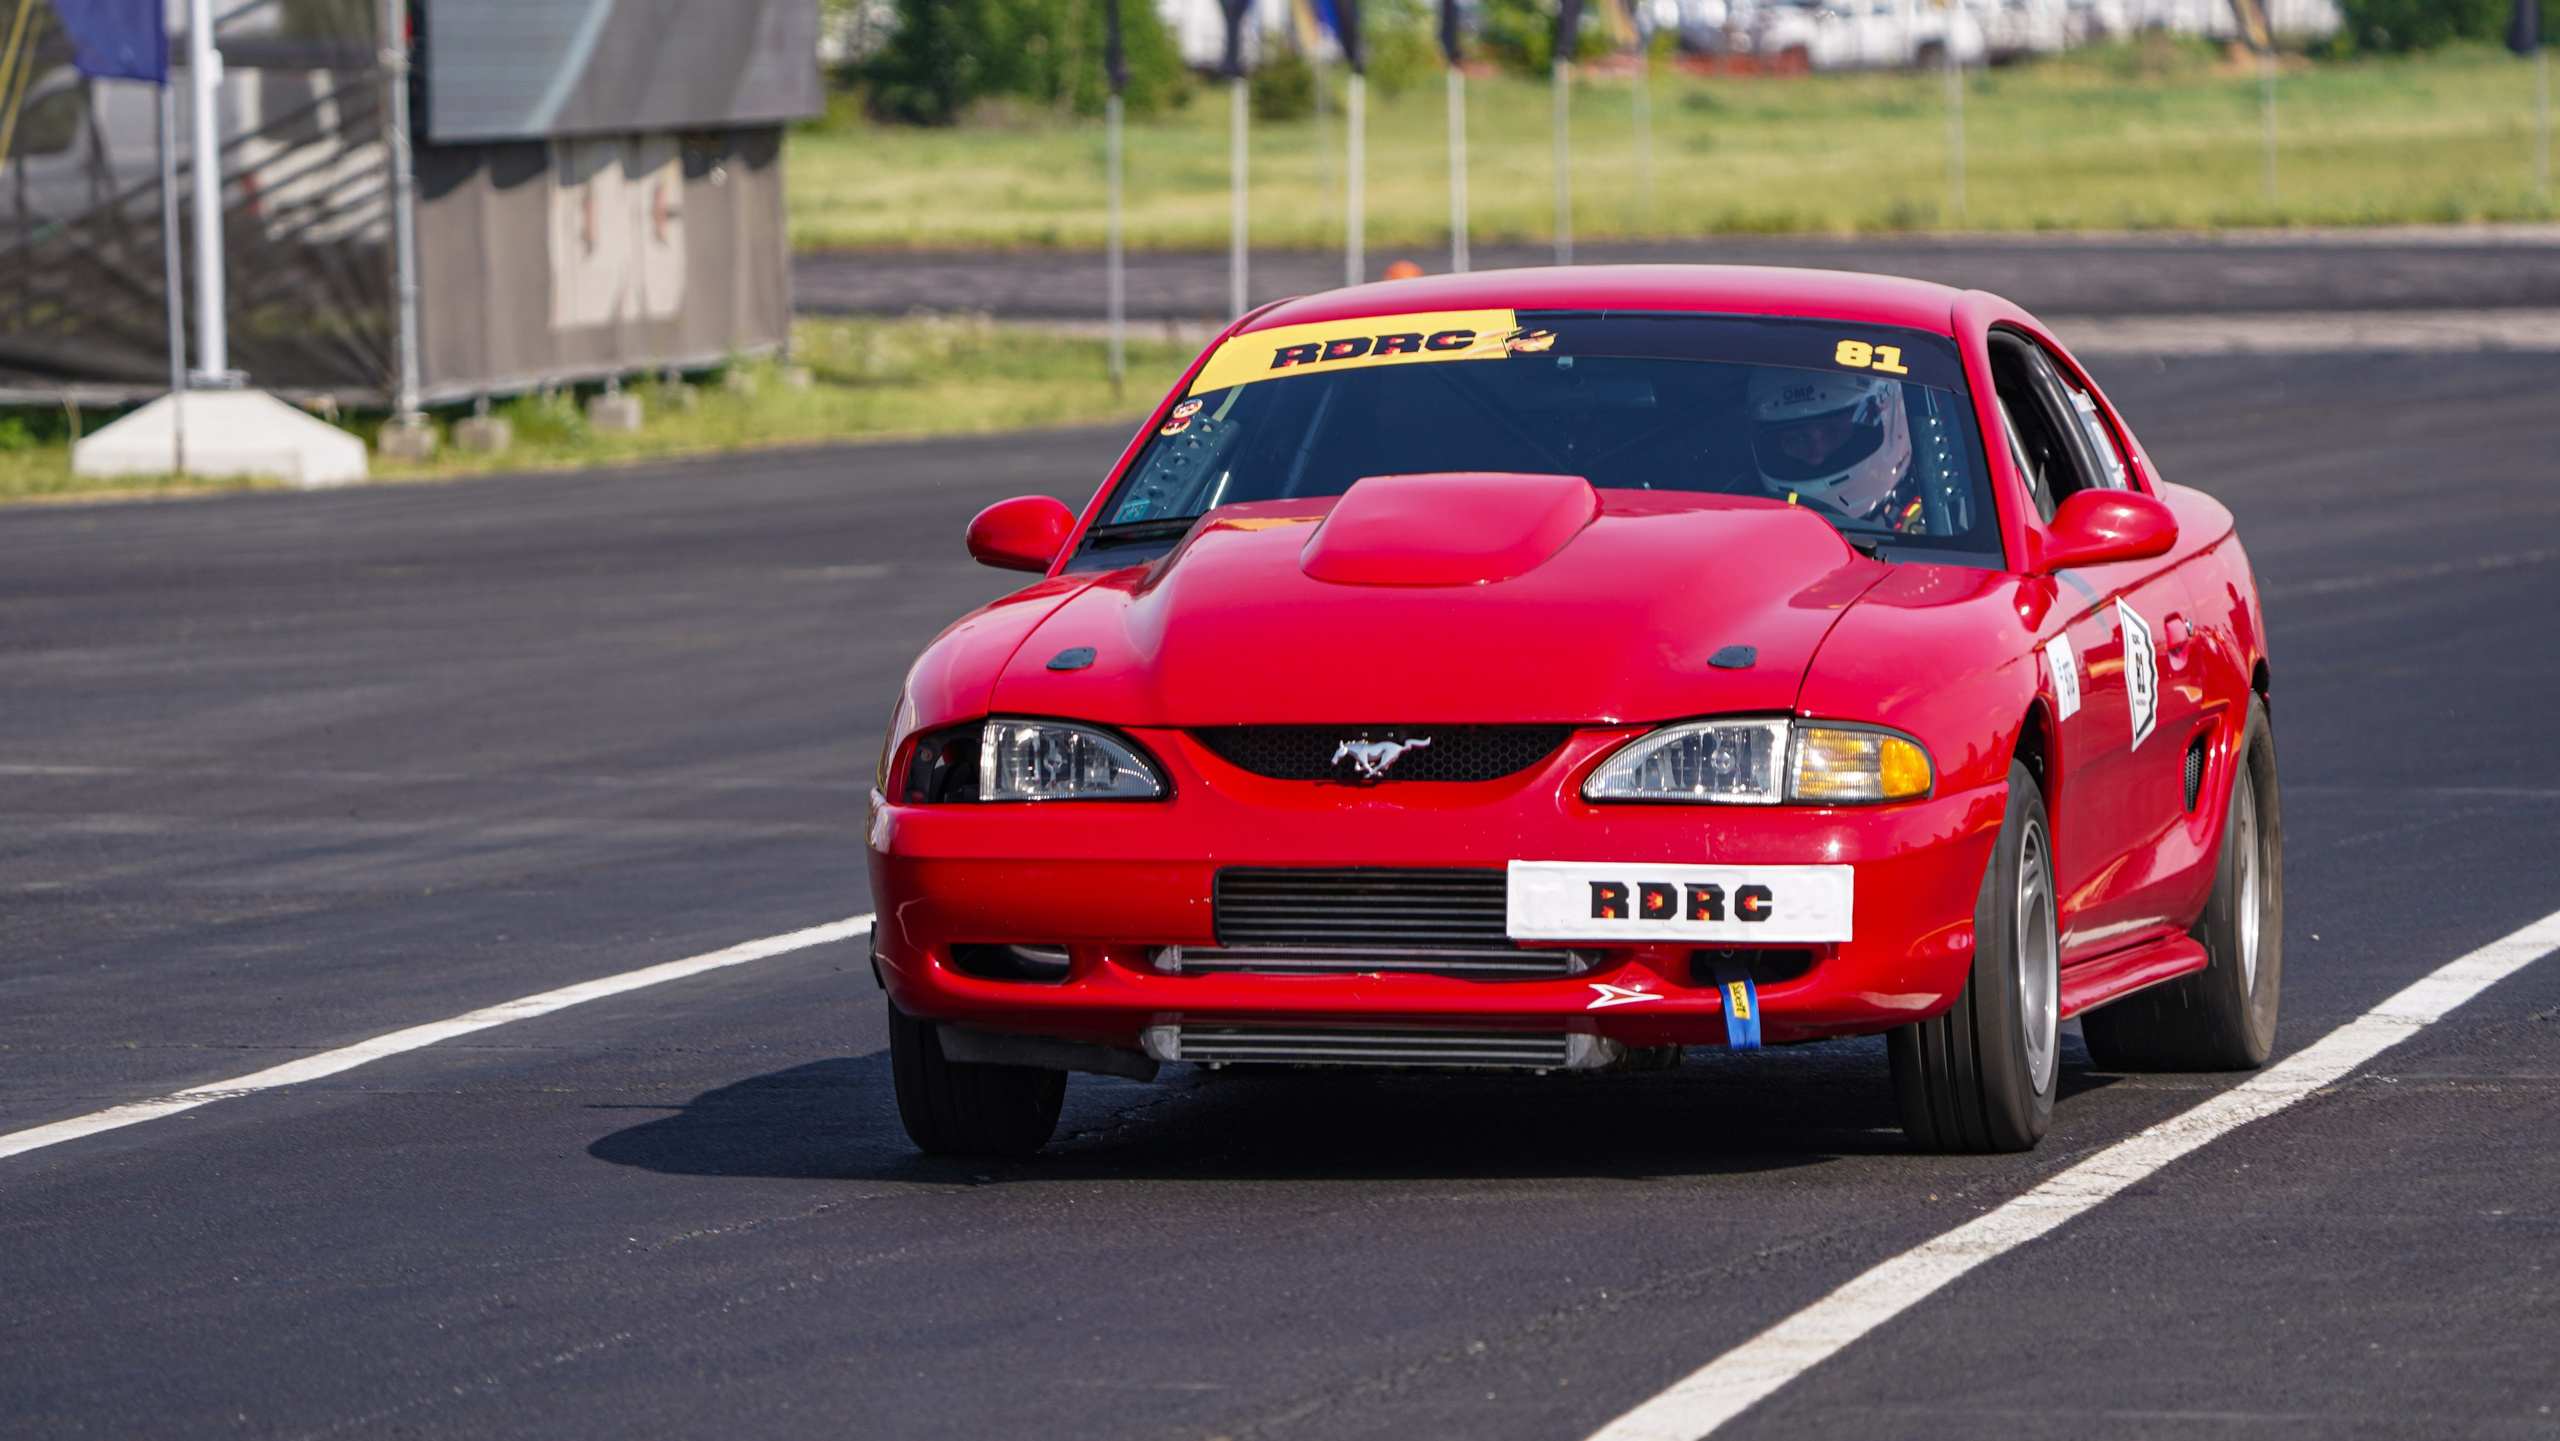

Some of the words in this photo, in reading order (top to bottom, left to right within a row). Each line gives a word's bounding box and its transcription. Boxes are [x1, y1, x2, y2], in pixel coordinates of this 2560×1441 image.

[1269, 330, 1477, 370] RDRC
[1835, 340, 1908, 375] 81
[1783, 383, 1815, 401] OMP
[1588, 880, 1773, 923] RDRC
